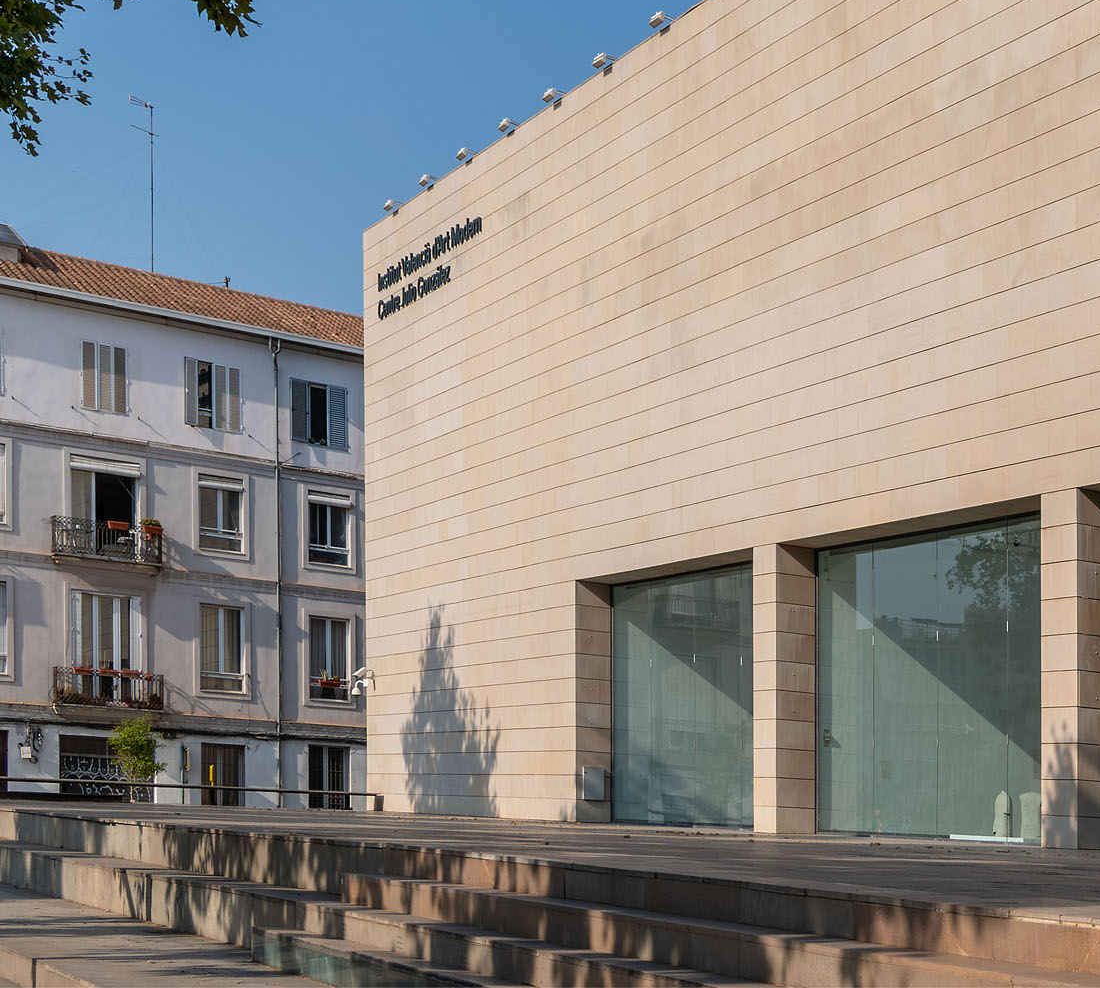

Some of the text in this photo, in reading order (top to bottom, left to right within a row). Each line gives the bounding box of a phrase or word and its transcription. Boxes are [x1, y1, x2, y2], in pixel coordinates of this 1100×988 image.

[377, 261, 402, 292] Institut
[450, 217, 483, 249] Modern
[378, 294, 401, 321] Centre
[400, 283, 417, 309] Julio
